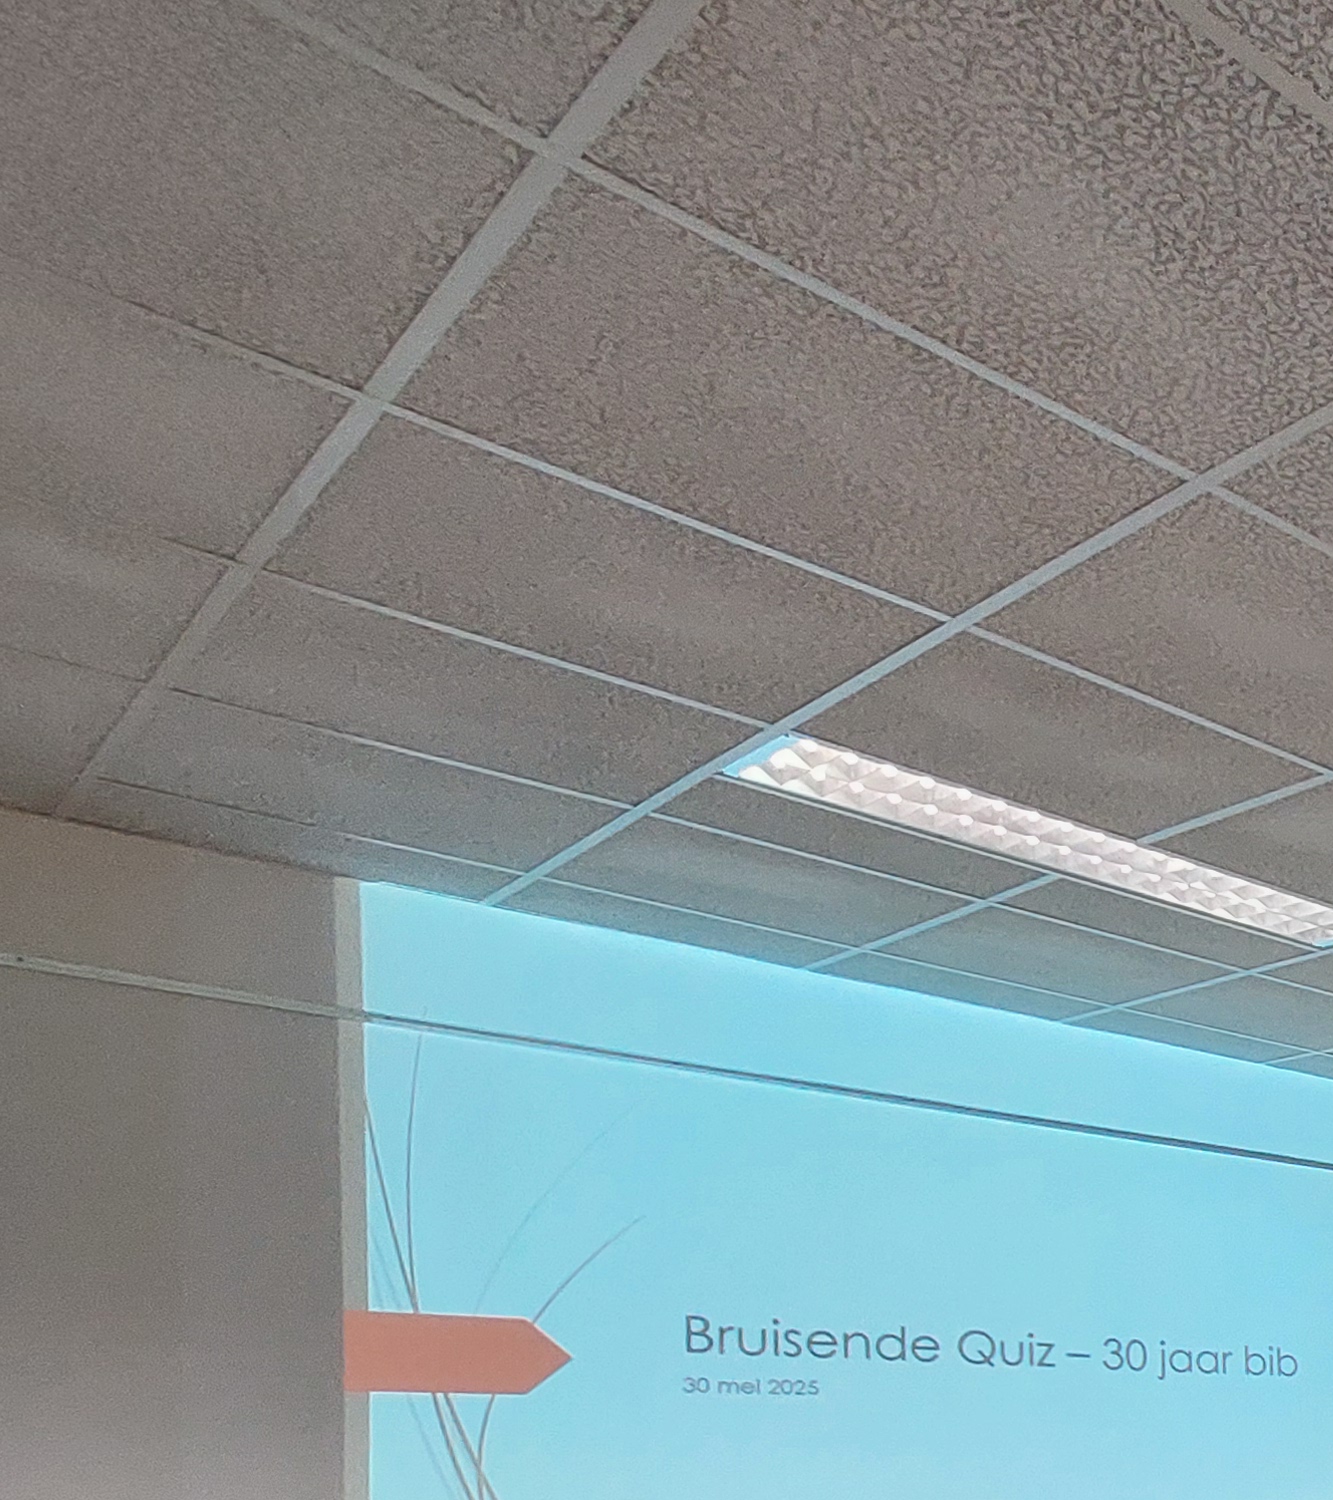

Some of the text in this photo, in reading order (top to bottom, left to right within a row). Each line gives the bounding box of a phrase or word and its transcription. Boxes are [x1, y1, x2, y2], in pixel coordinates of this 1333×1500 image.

[685, 1314, 940, 1363] Bruisende
[957, 1329, 1056, 1367] Quiz
[1102, 1338, 1147, 1371] 30
[1157, 1340, 1233, 1380] jaar
[1244, 1345, 1298, 1377] bib
[682, 1377, 710, 1394] 30
[767, 1379, 820, 1396] 2025
